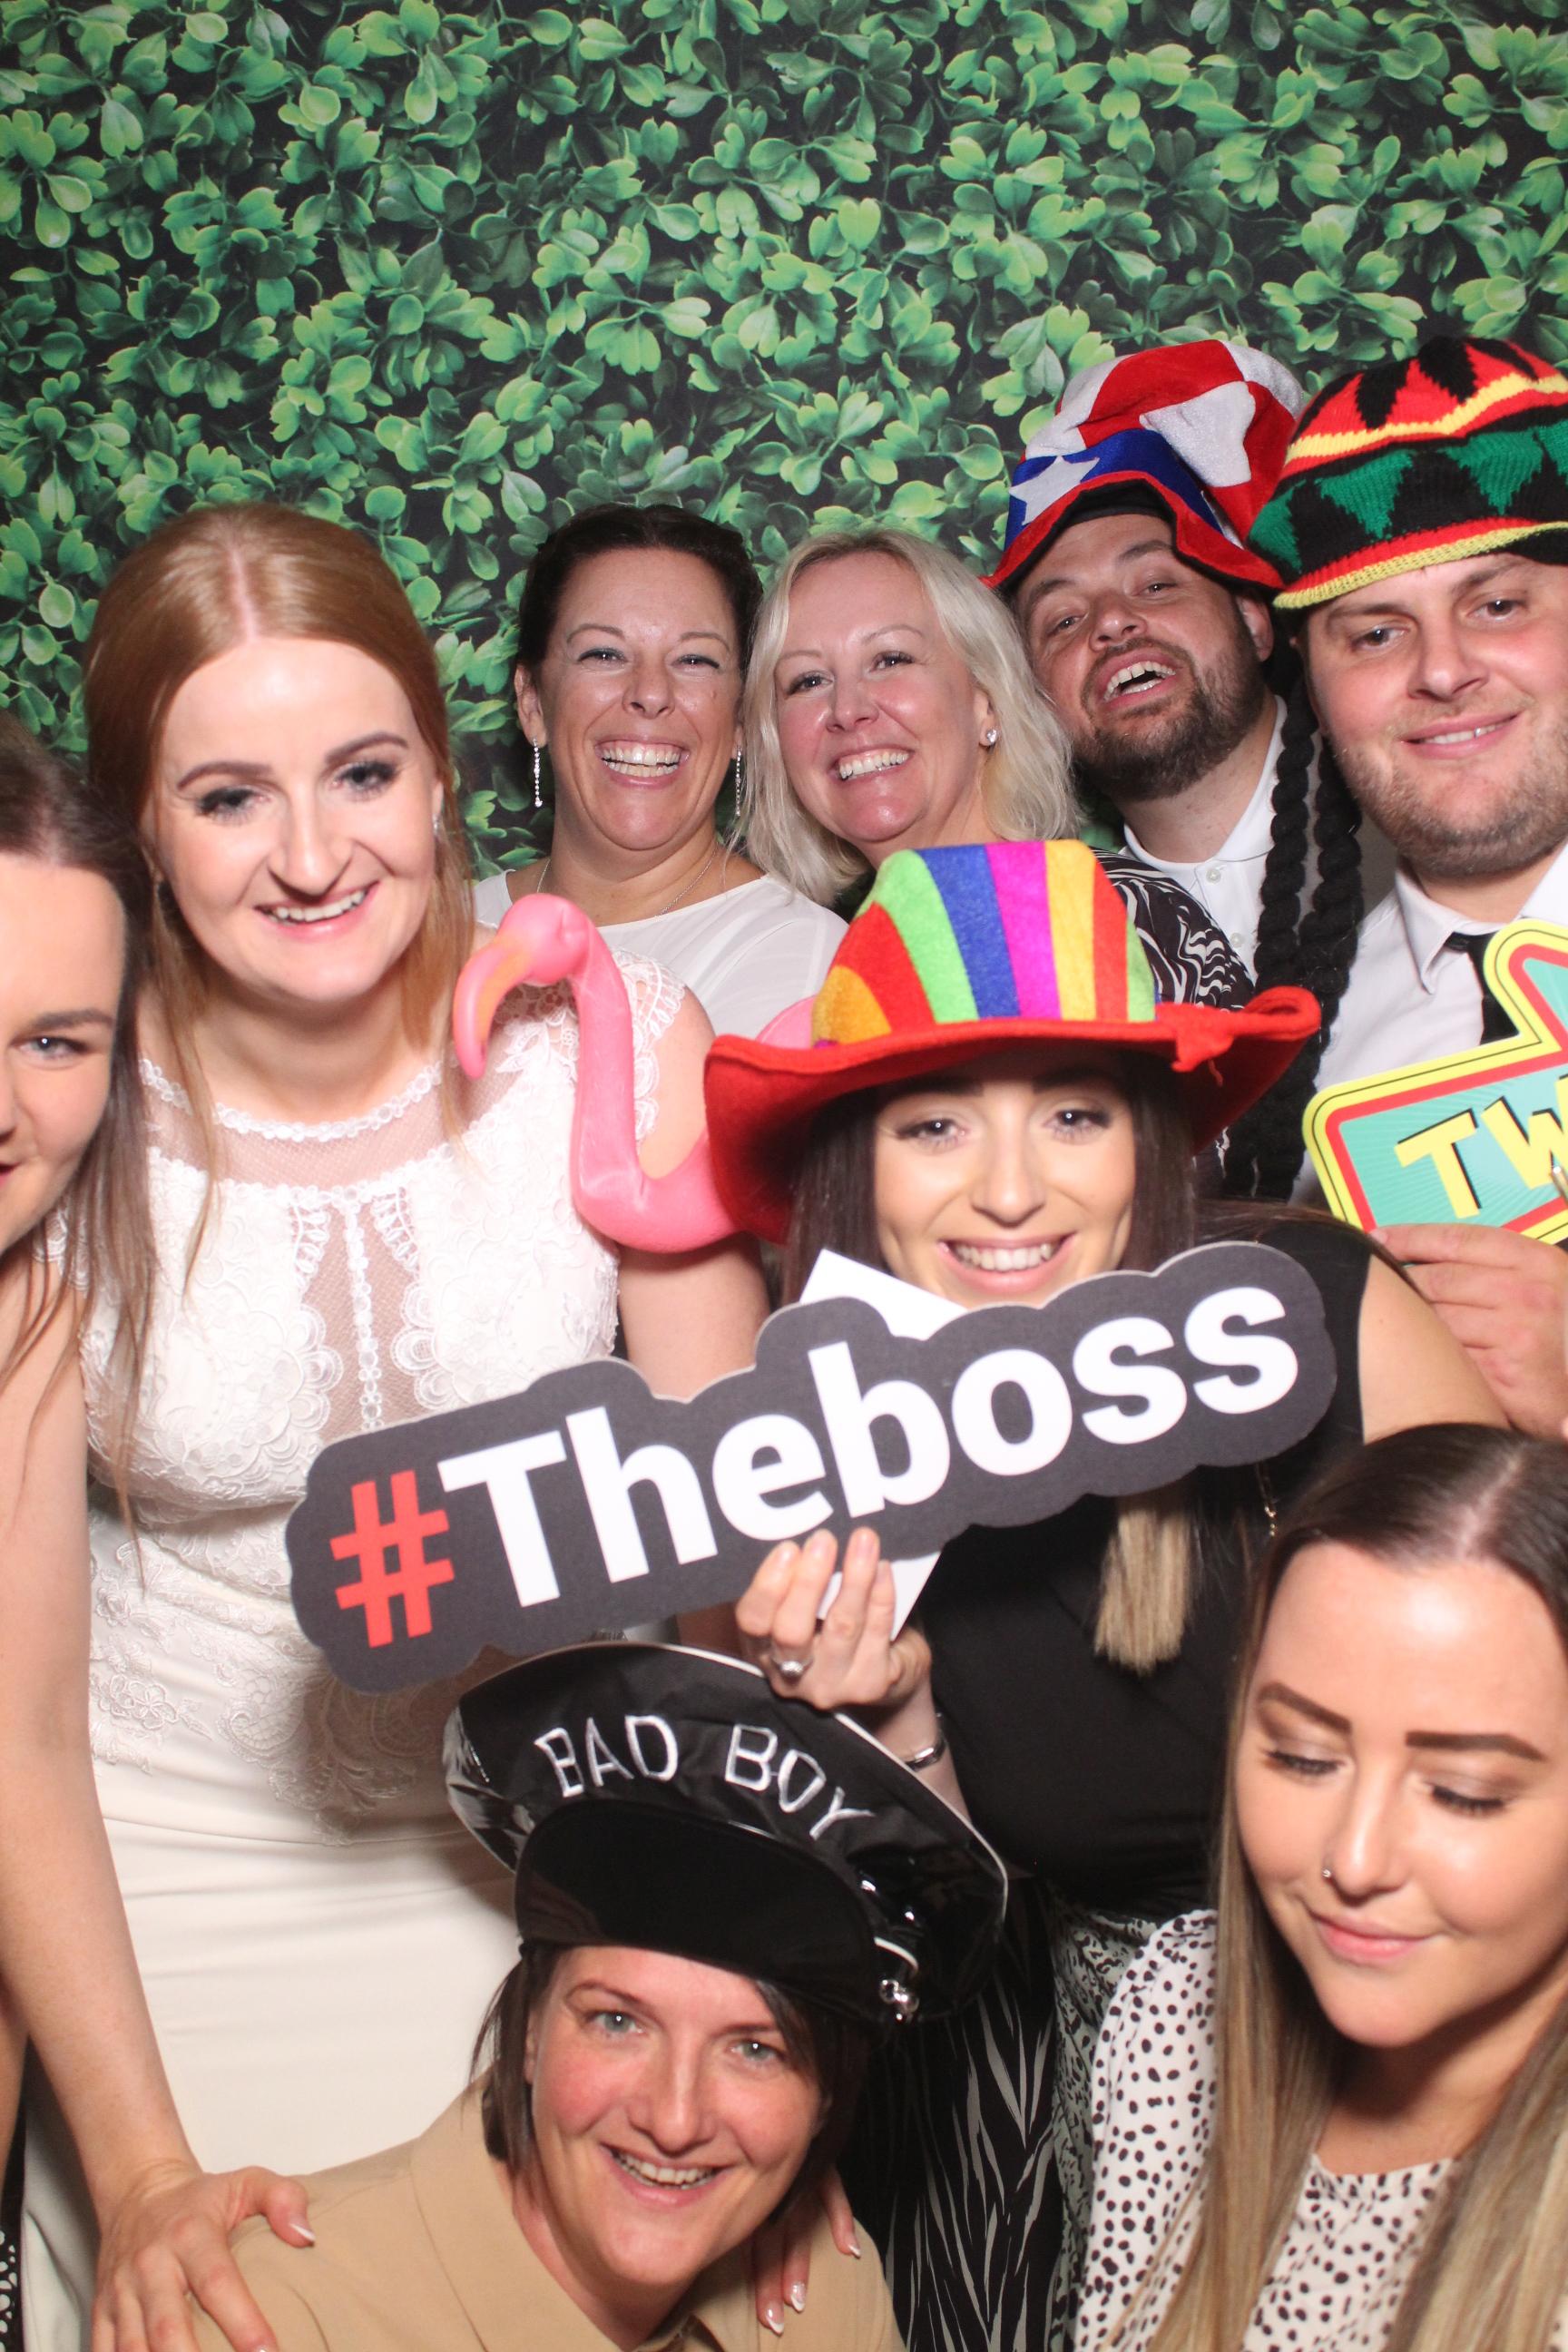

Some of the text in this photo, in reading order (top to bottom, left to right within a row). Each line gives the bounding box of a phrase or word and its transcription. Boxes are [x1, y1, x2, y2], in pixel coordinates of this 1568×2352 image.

[329, 1287, 1298, 1648] #Theboss
[534, 1715, 876, 1839] BAD BOY
